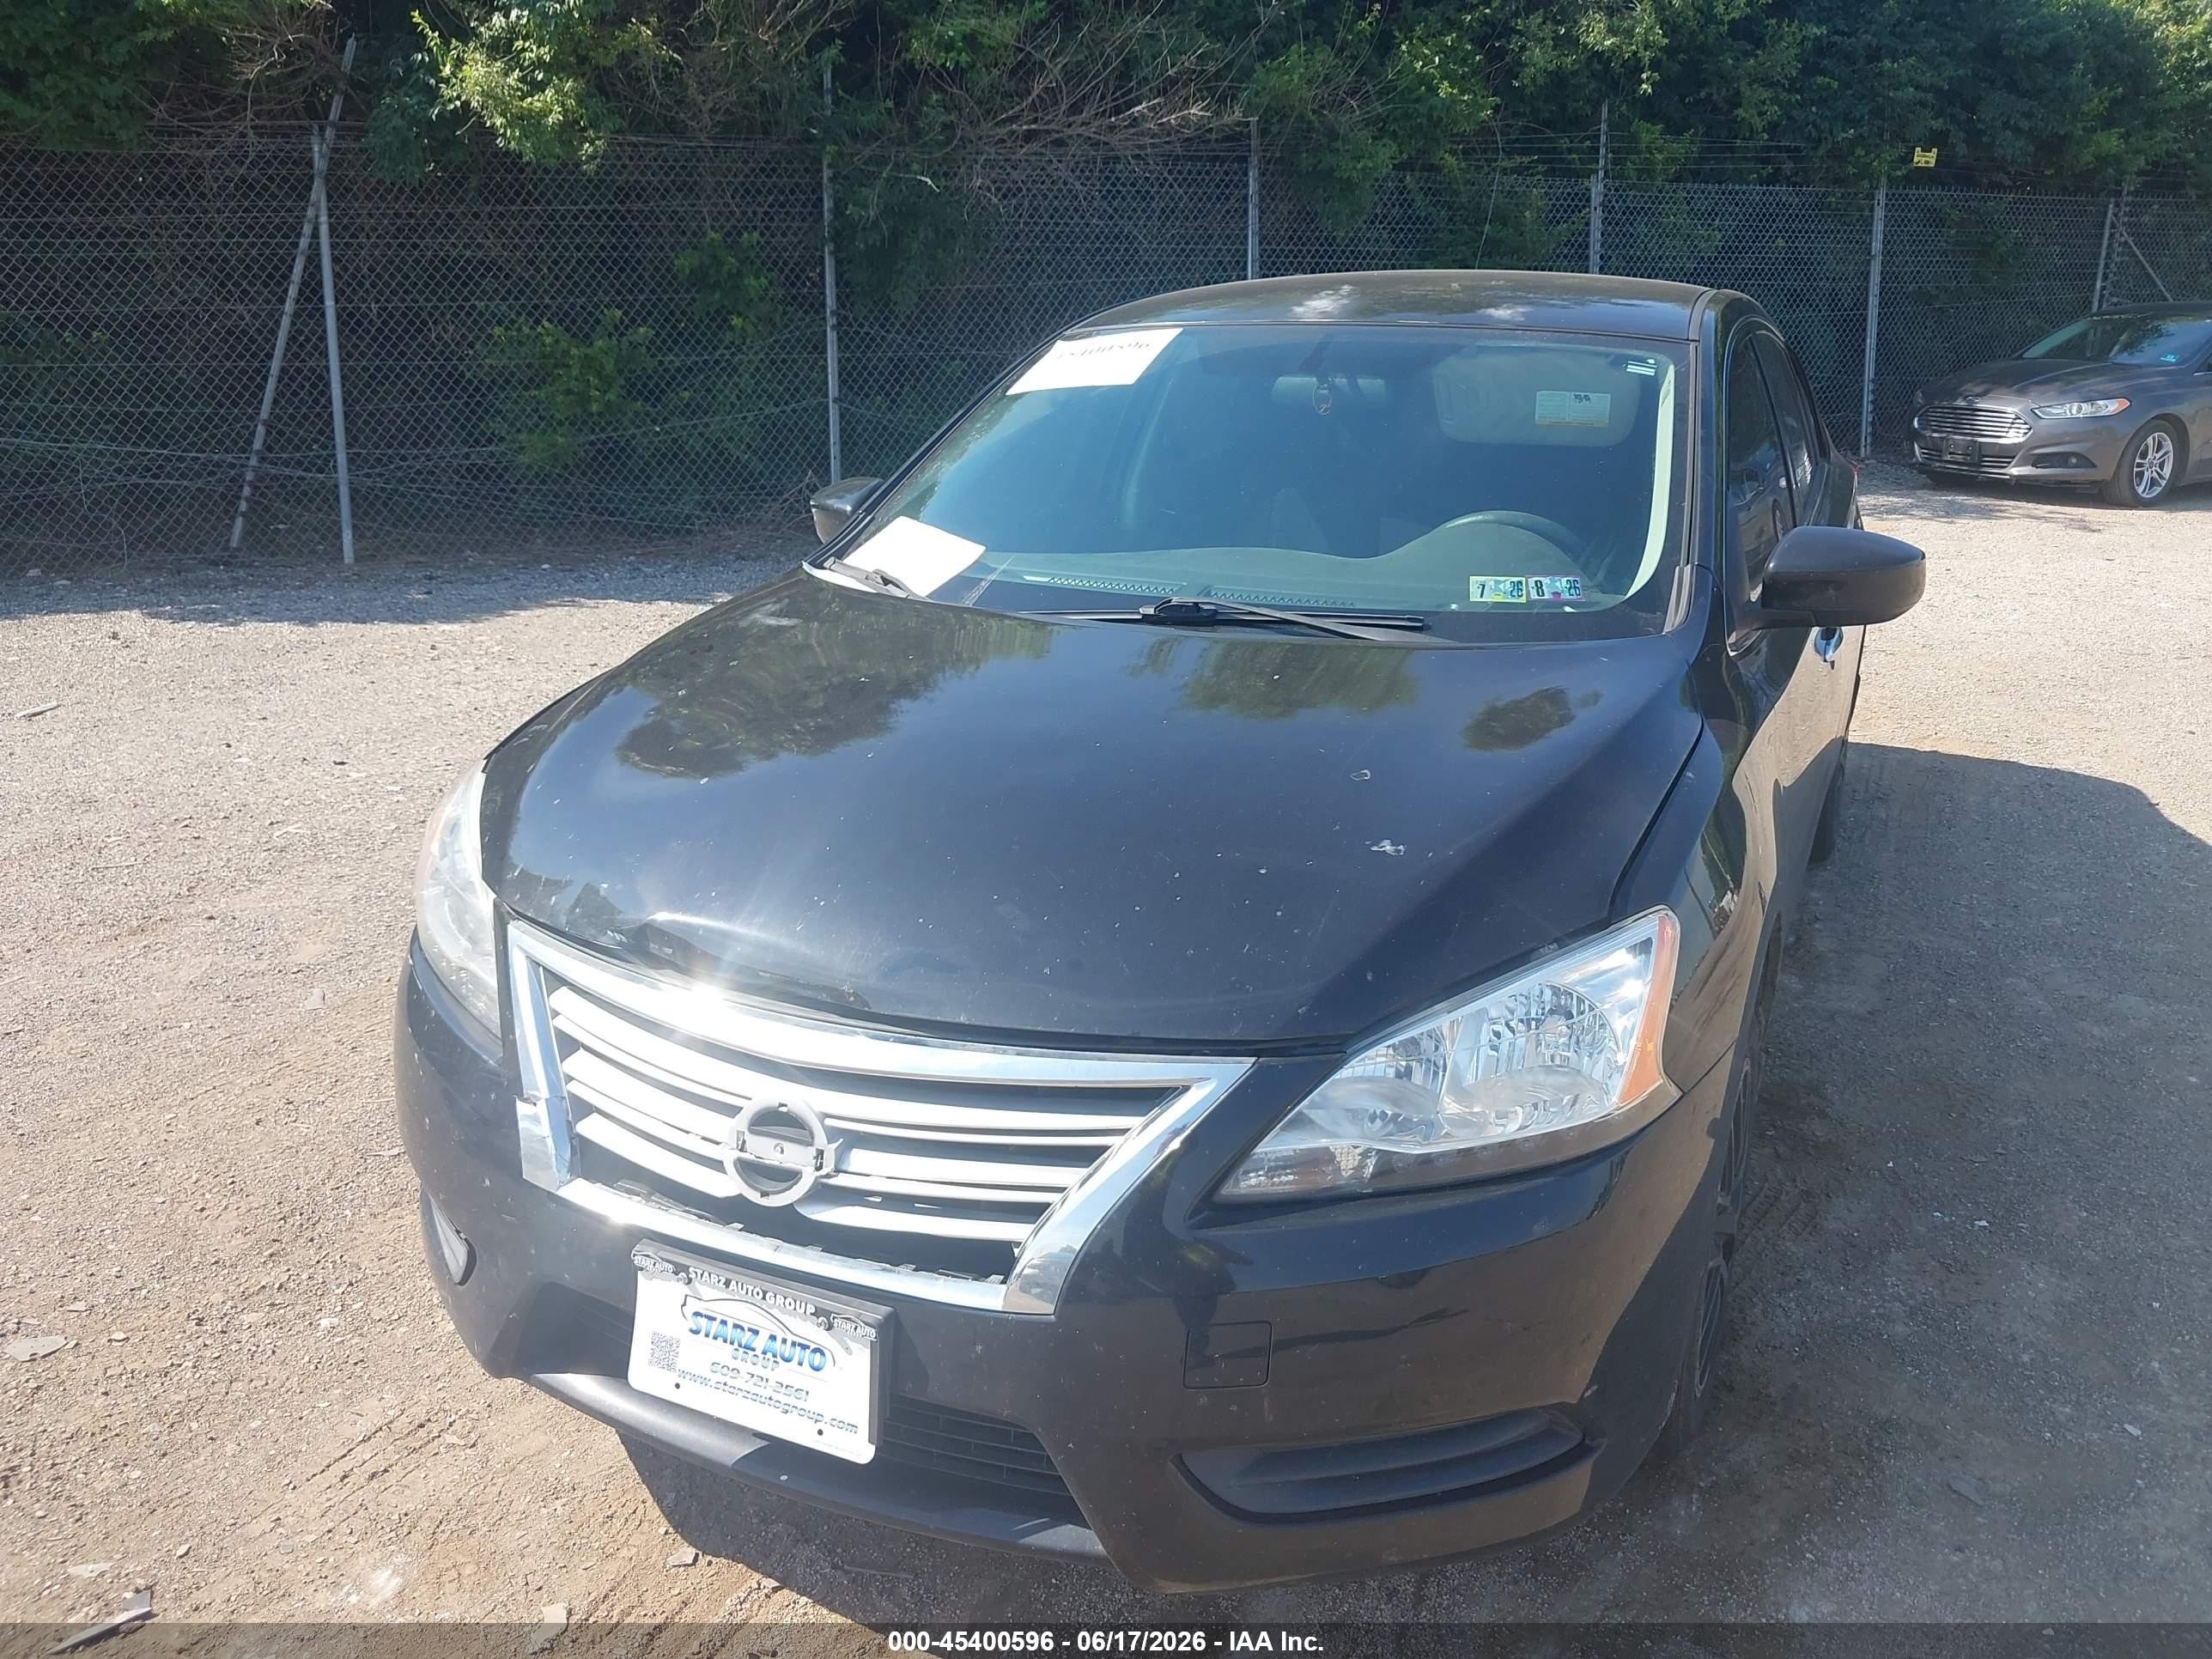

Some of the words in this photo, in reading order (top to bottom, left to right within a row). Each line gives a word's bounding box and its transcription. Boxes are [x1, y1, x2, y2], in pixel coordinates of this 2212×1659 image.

[1567, 579, 1582, 597] 26
[688, 1266, 726, 1287] STARZ
[729, 1279, 764, 1301] AUTO
[765, 1291, 817, 1316] GROUP
[688, 1310, 759, 1352] STARZ
[761, 1334, 827, 1373] AUTO
[731, 1347, 780, 1372] GROUP
[677, 1369, 859, 1434] www.starzautogroup.com
